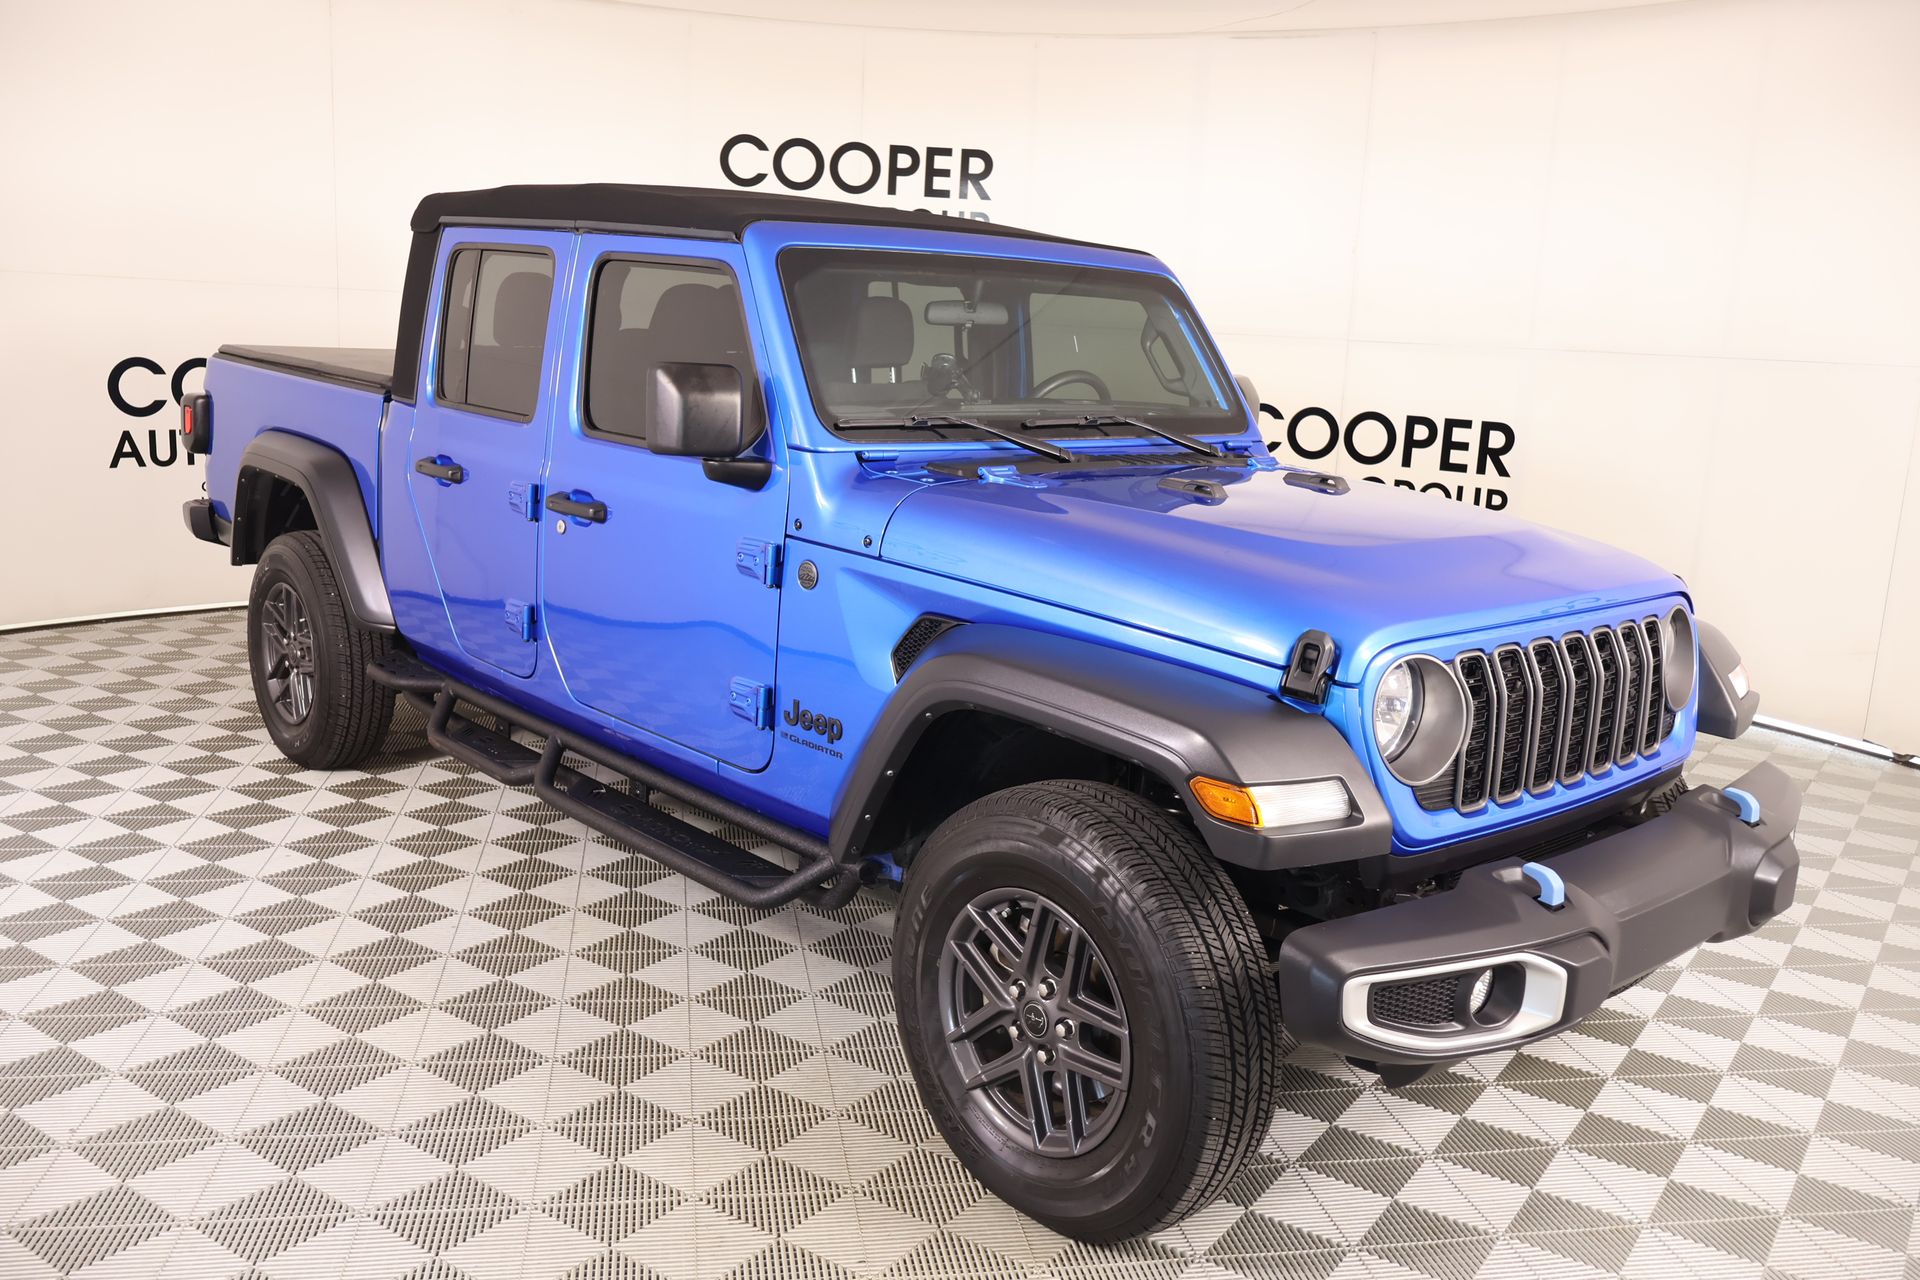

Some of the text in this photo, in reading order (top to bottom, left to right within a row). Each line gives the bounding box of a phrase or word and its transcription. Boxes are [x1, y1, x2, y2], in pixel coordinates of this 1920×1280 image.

[720, 134, 993, 200] COOPER
[784, 699, 843, 745] Jeep
[789, 735, 843, 760] GLADIATOR
